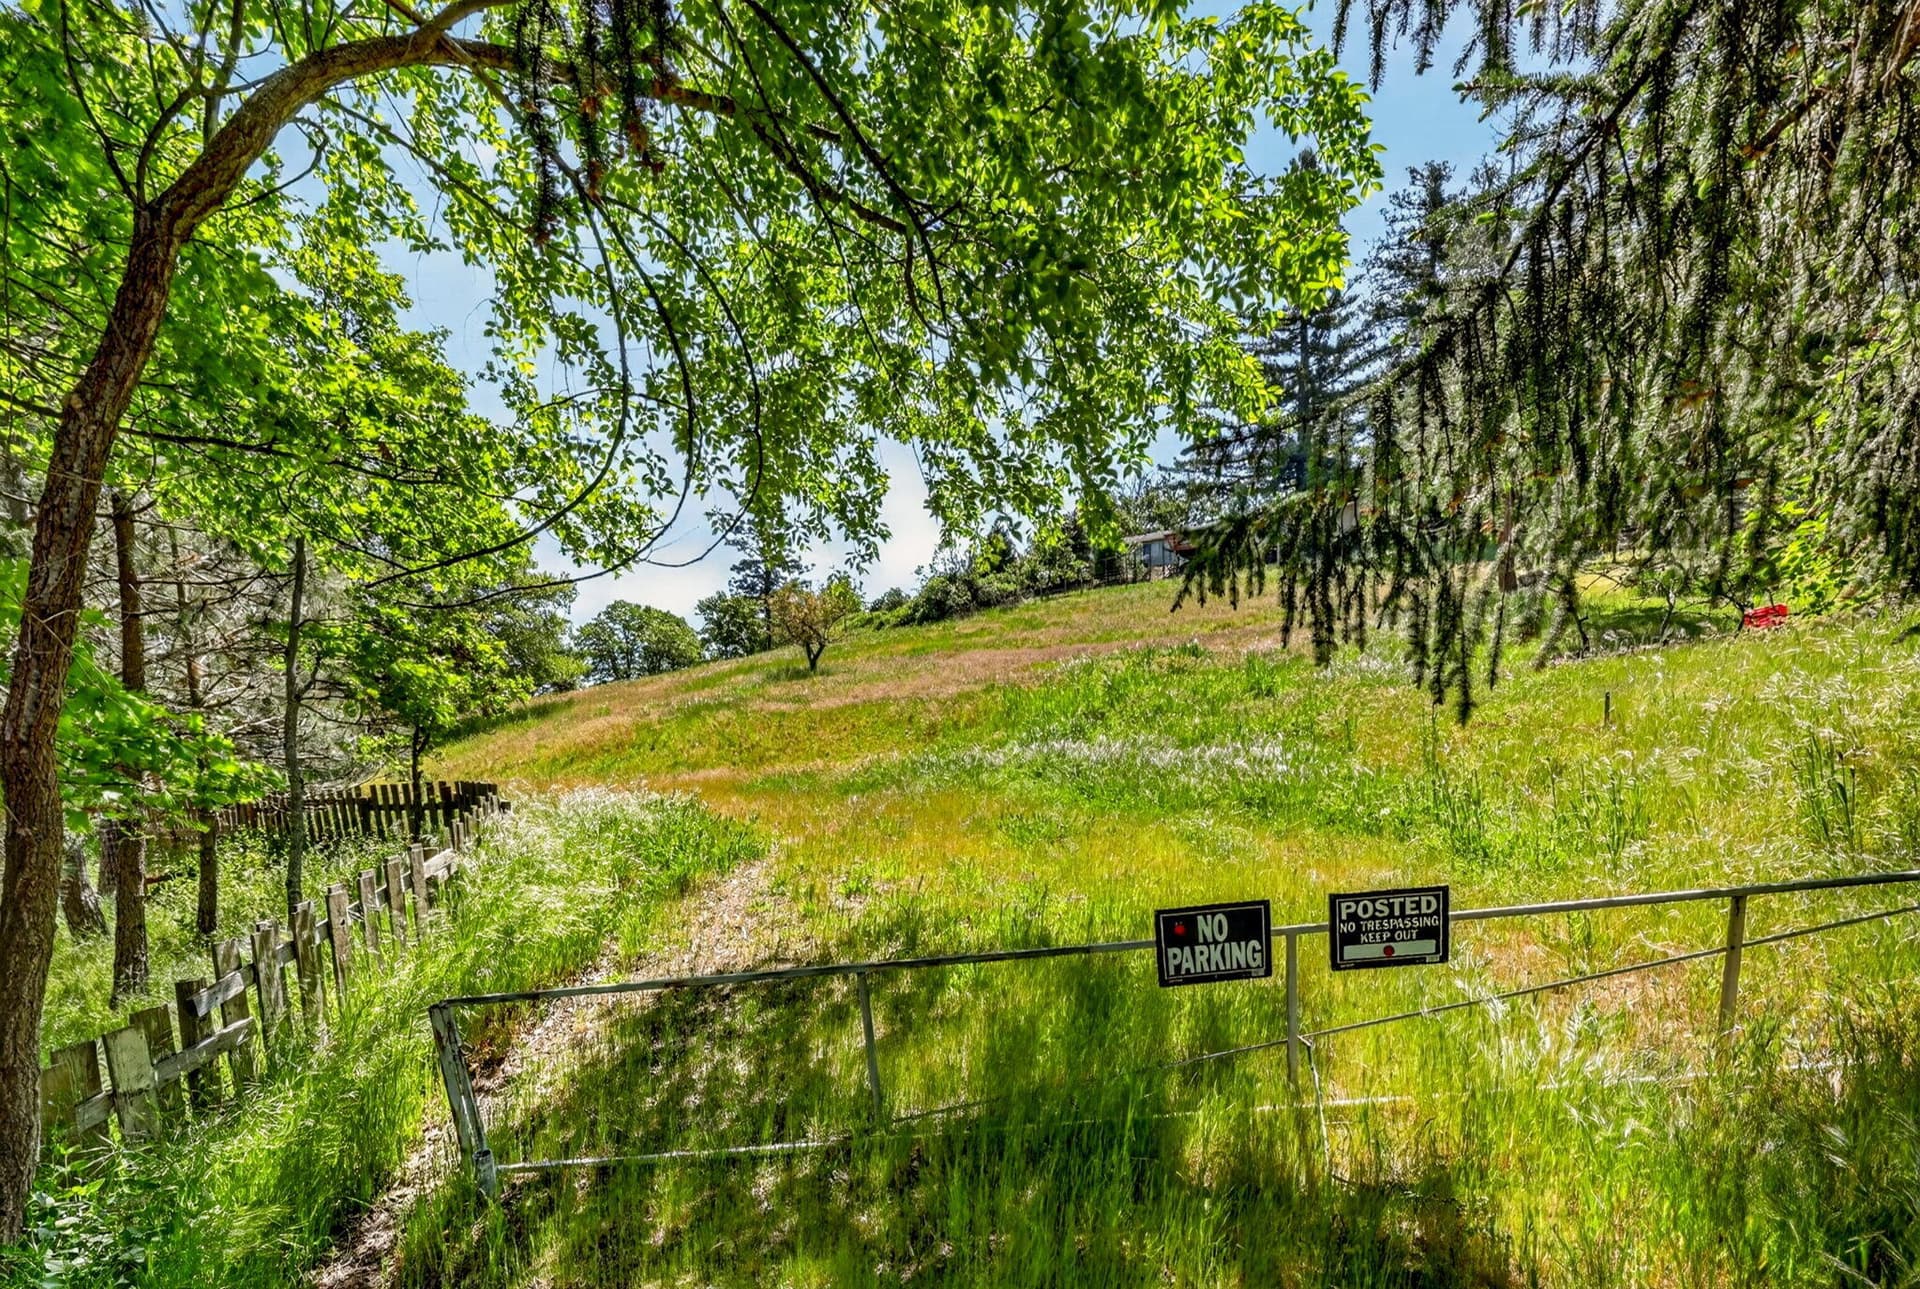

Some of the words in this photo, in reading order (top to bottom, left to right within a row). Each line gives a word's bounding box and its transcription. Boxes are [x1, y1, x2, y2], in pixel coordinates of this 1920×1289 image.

[1340, 896, 1438, 920] POSTED
[1197, 913, 1228, 943] NO
[1340, 922, 1355, 933] NO
[1360, 915, 1439, 931] TRESPASSING
[1360, 931, 1390, 943] KEEP
[1395, 929, 1417, 940] OUT
[1168, 940, 1262, 975] PARKING
